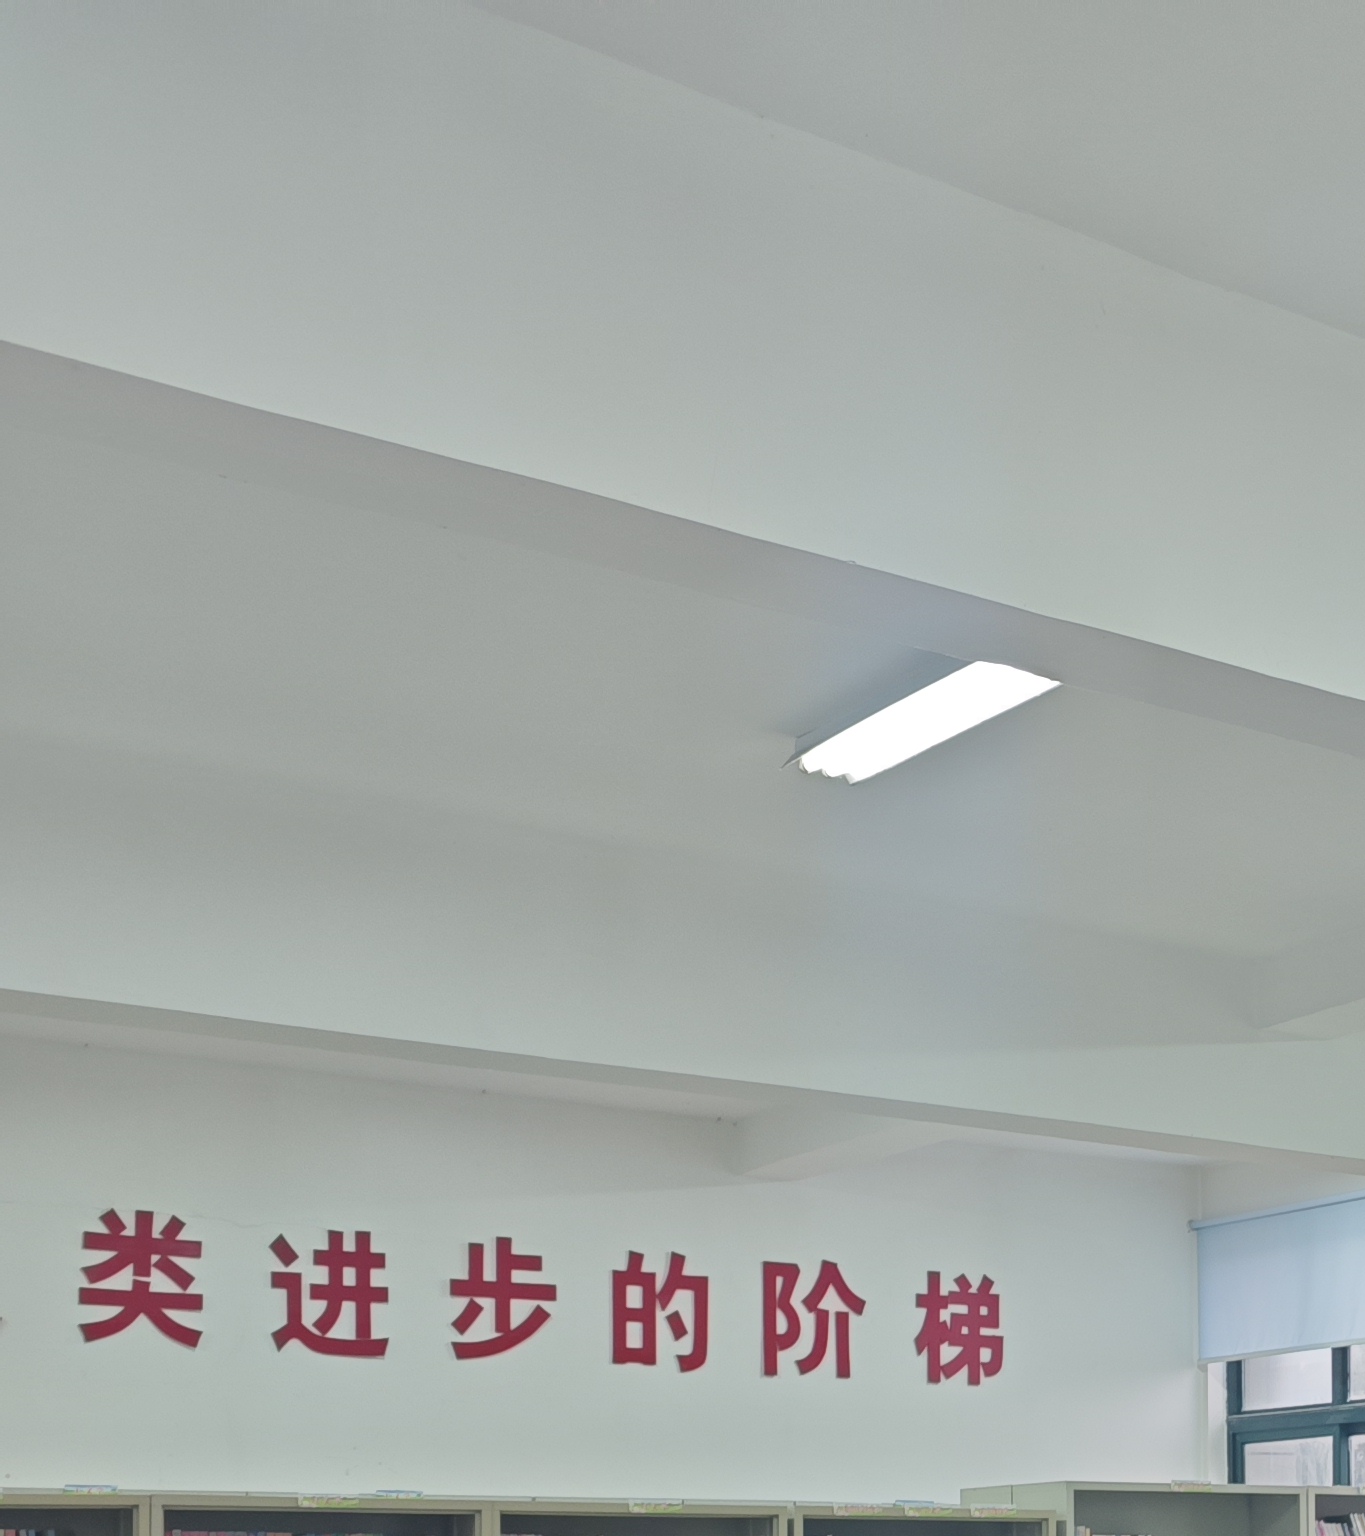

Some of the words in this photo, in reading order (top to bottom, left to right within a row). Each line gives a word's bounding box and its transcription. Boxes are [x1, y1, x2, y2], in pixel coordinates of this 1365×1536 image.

[77, 1208, 1004, 1385] 类进步的阶梯
